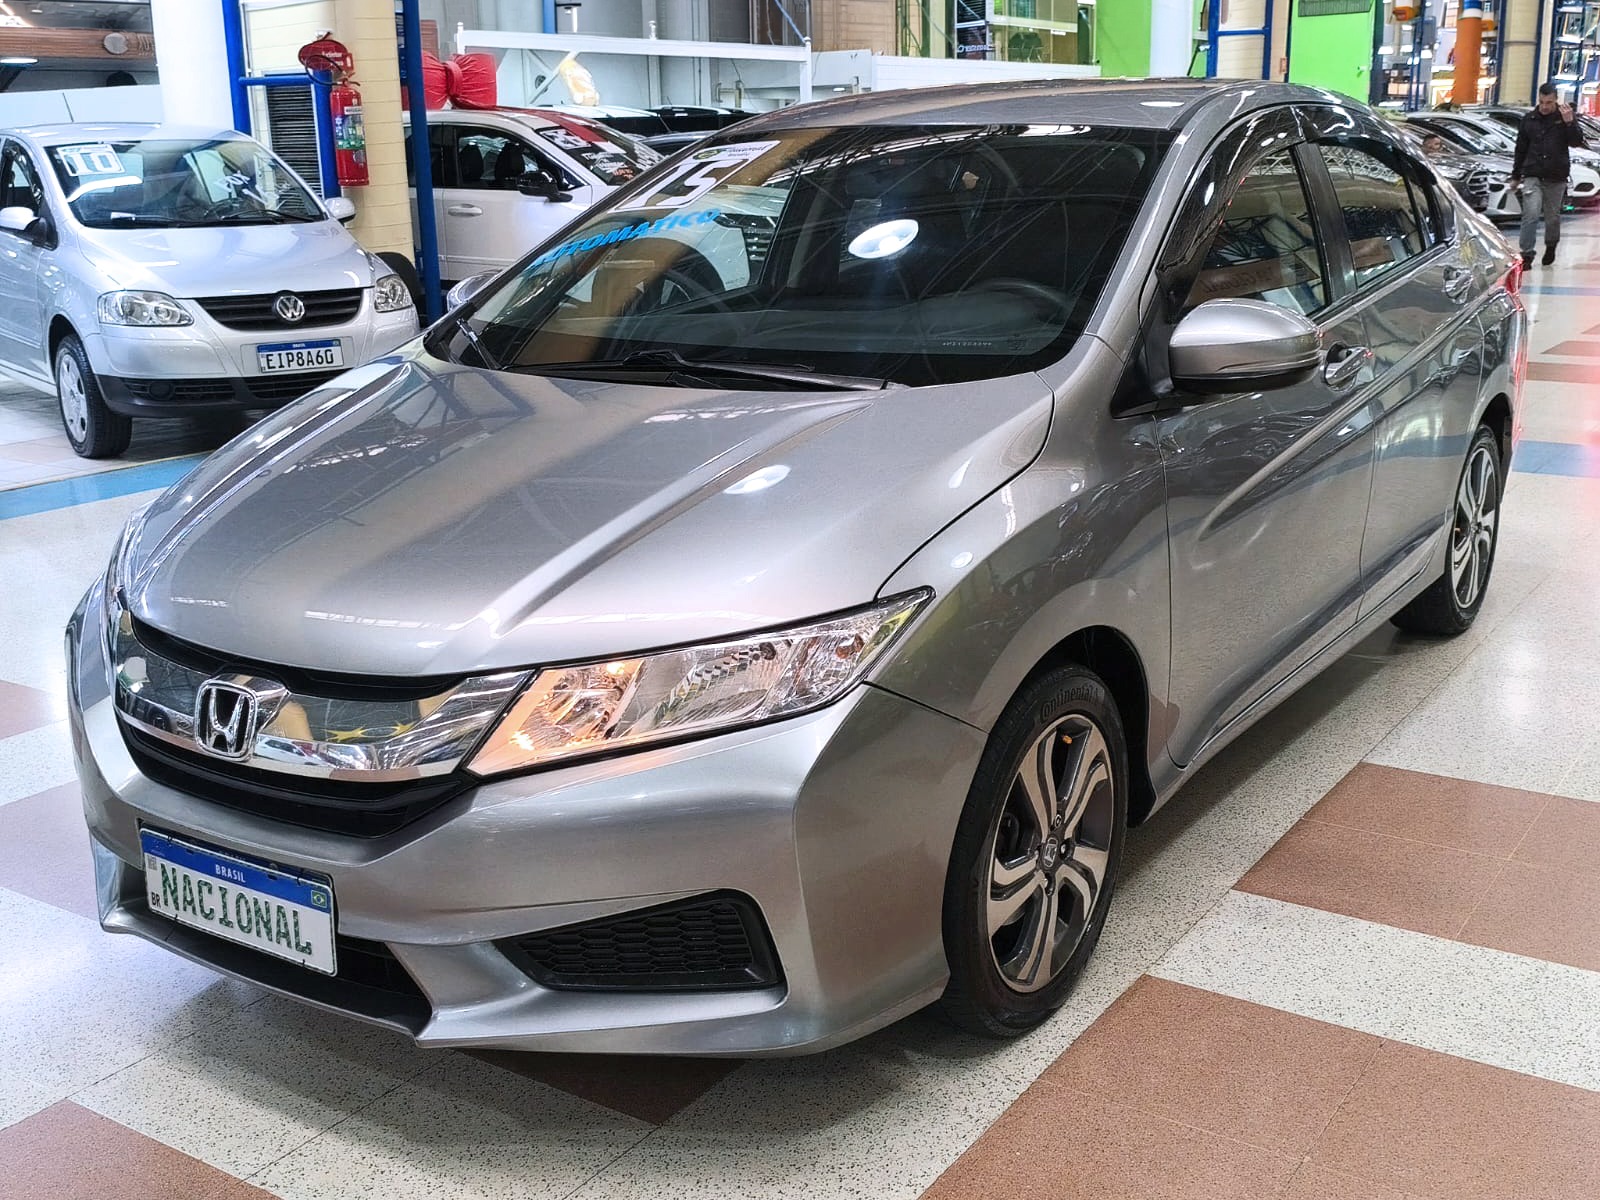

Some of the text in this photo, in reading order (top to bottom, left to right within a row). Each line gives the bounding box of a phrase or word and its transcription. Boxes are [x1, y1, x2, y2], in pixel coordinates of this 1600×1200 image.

[214, 863, 247, 884] BRASIL
[151, 891, 161, 908] BR
[160, 863, 312, 955] NACIONAL
